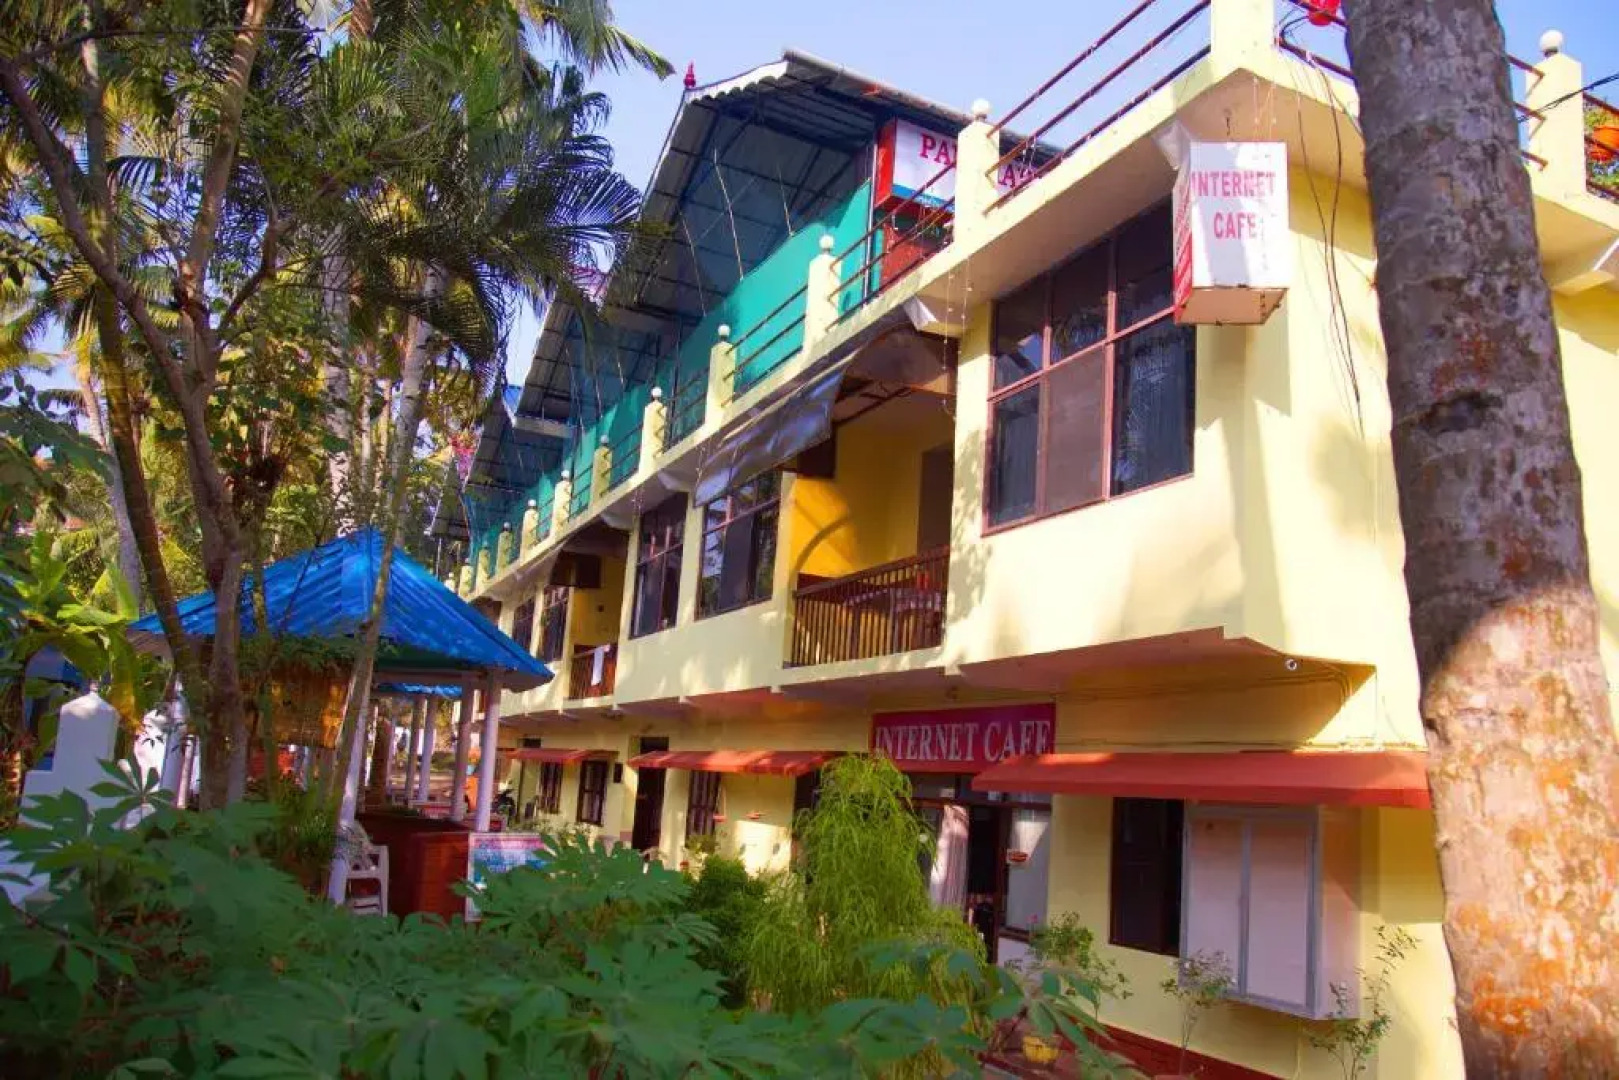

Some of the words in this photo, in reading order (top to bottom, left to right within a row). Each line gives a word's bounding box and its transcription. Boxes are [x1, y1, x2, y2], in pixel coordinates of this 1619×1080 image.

[1191, 171, 1276, 197] INTERNET
[1213, 212, 1257, 240] CAFE
[875, 722, 980, 762] INTERNET
